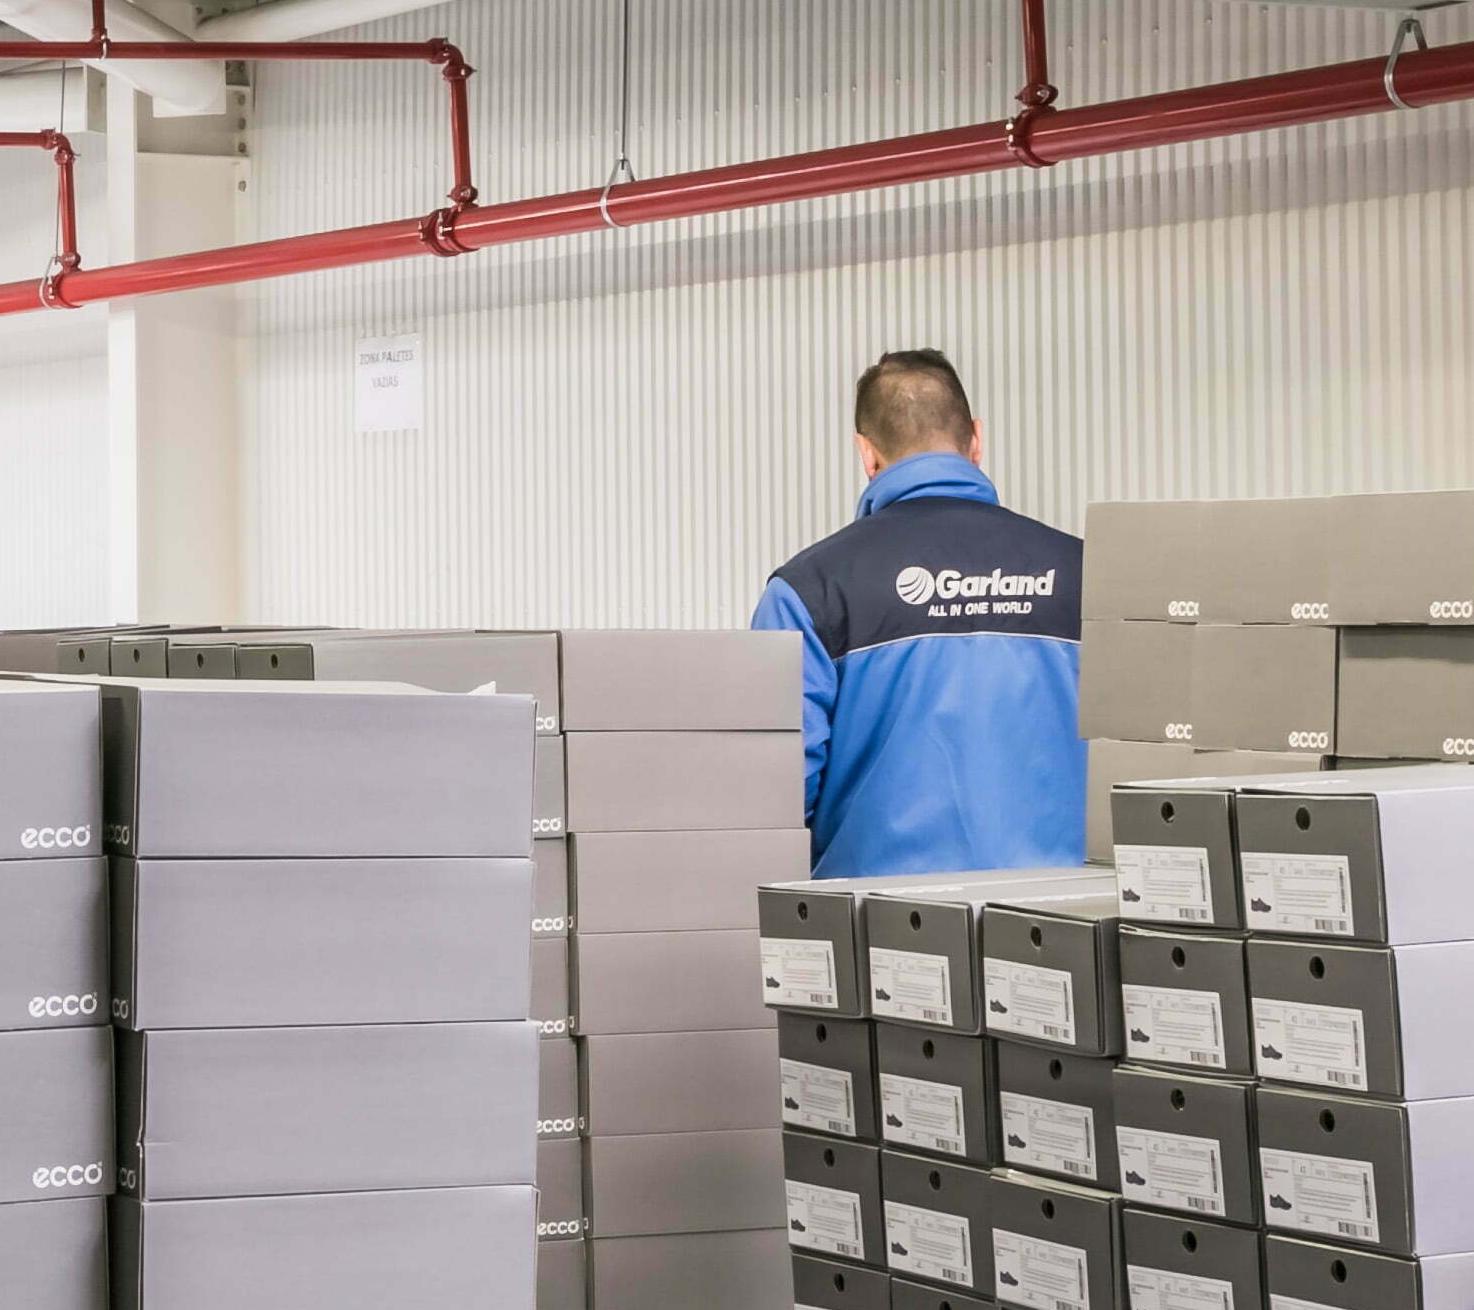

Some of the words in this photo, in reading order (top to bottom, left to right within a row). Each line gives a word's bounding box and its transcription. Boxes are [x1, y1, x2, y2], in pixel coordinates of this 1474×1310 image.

[936, 568, 1056, 599] Garland
[928, 605, 947, 616] ALL
[950, 605, 961, 615] IN
[965, 603, 988, 614] ONE
[993, 602, 1031, 613] WORLD
[1429, 600, 1473, 619] ecco
[1164, 722, 1193, 740] ecc
[1288, 731, 1329, 749] ecco
[532, 816, 562, 833] cco
[20, 824, 91, 849] ecco
[533, 916, 565, 932] cco
[28, 994, 95, 1018] ecco
[112, 998, 129, 1019] co
[32, 1163, 102, 1189] ecco
[119, 1167, 136, 1189] co
[537, 1219, 580, 1236] ecco
